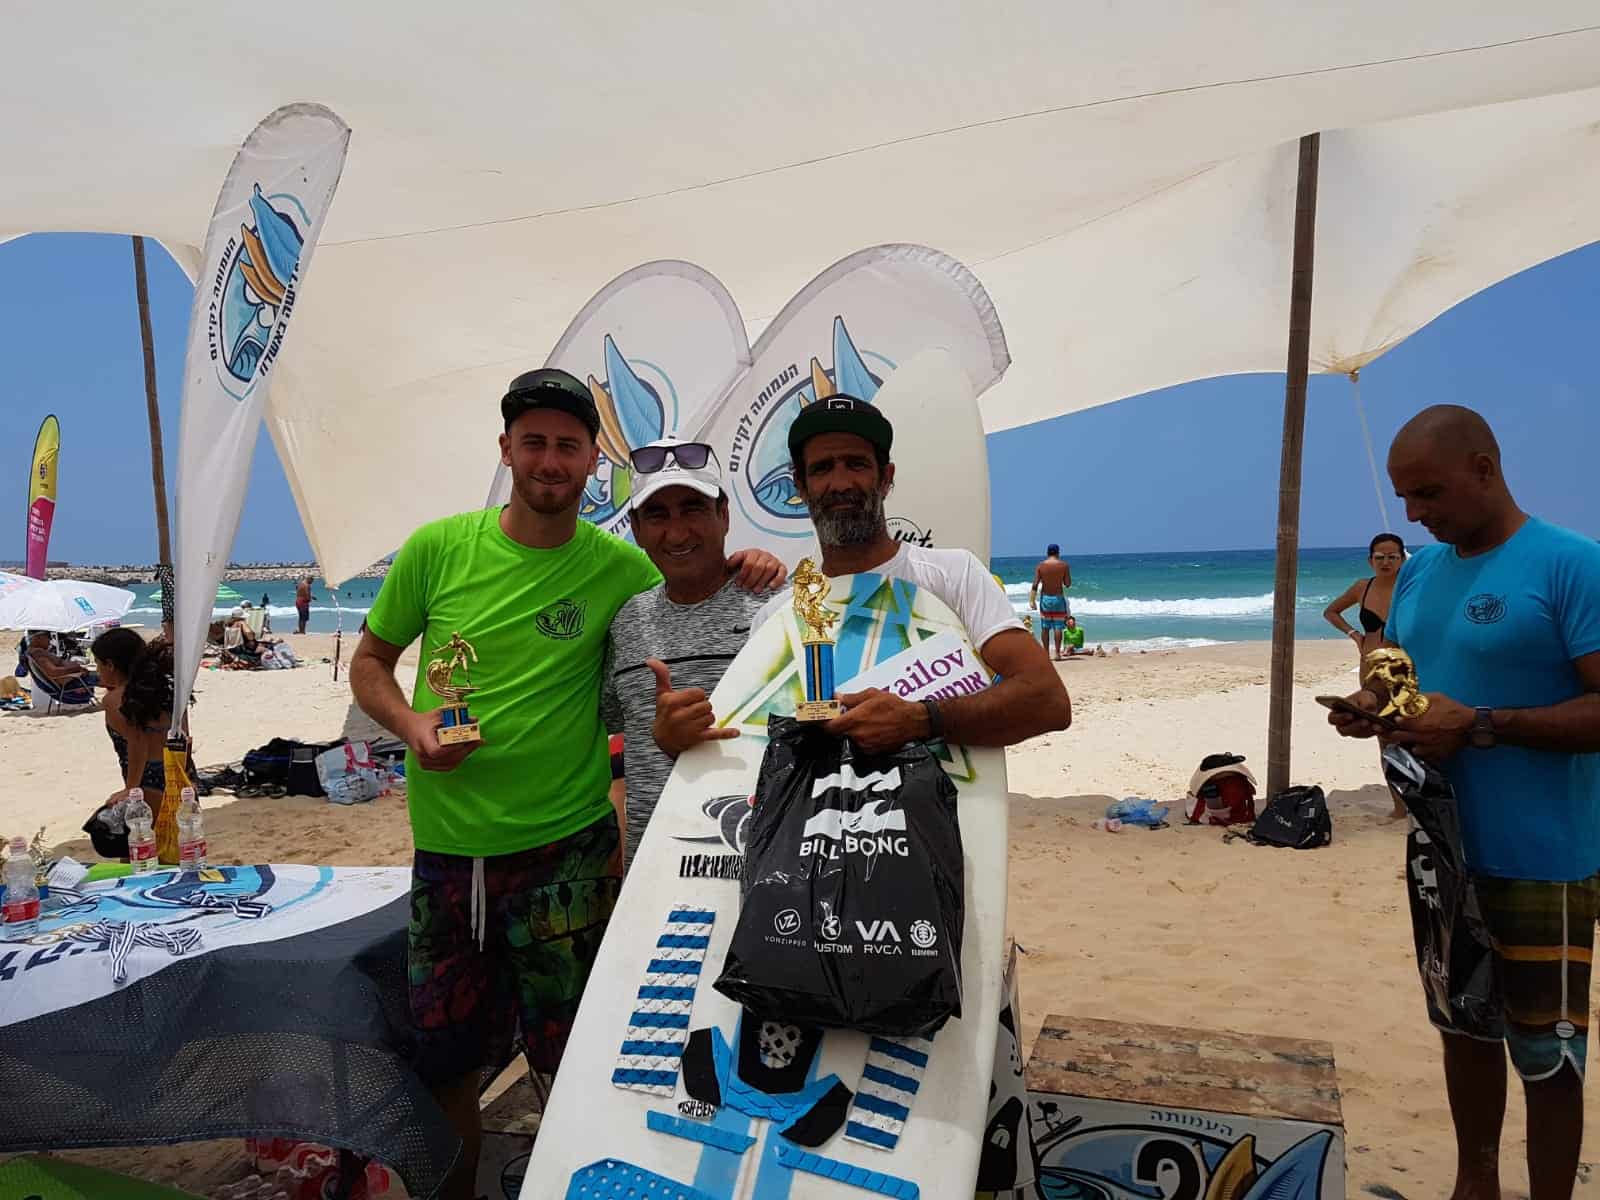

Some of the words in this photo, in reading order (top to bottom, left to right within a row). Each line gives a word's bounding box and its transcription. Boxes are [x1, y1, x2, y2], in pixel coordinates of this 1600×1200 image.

[213, 237, 236, 298] העמותה
[208, 300, 218, 361] לקידום
[750, 363, 800, 416] העמותה
[729, 413, 753, 473] לקידום
[799, 835, 909, 860] BILLBONG
[863, 944, 902, 955] RVCA
[1151, 1110, 1233, 1137] העמותה
